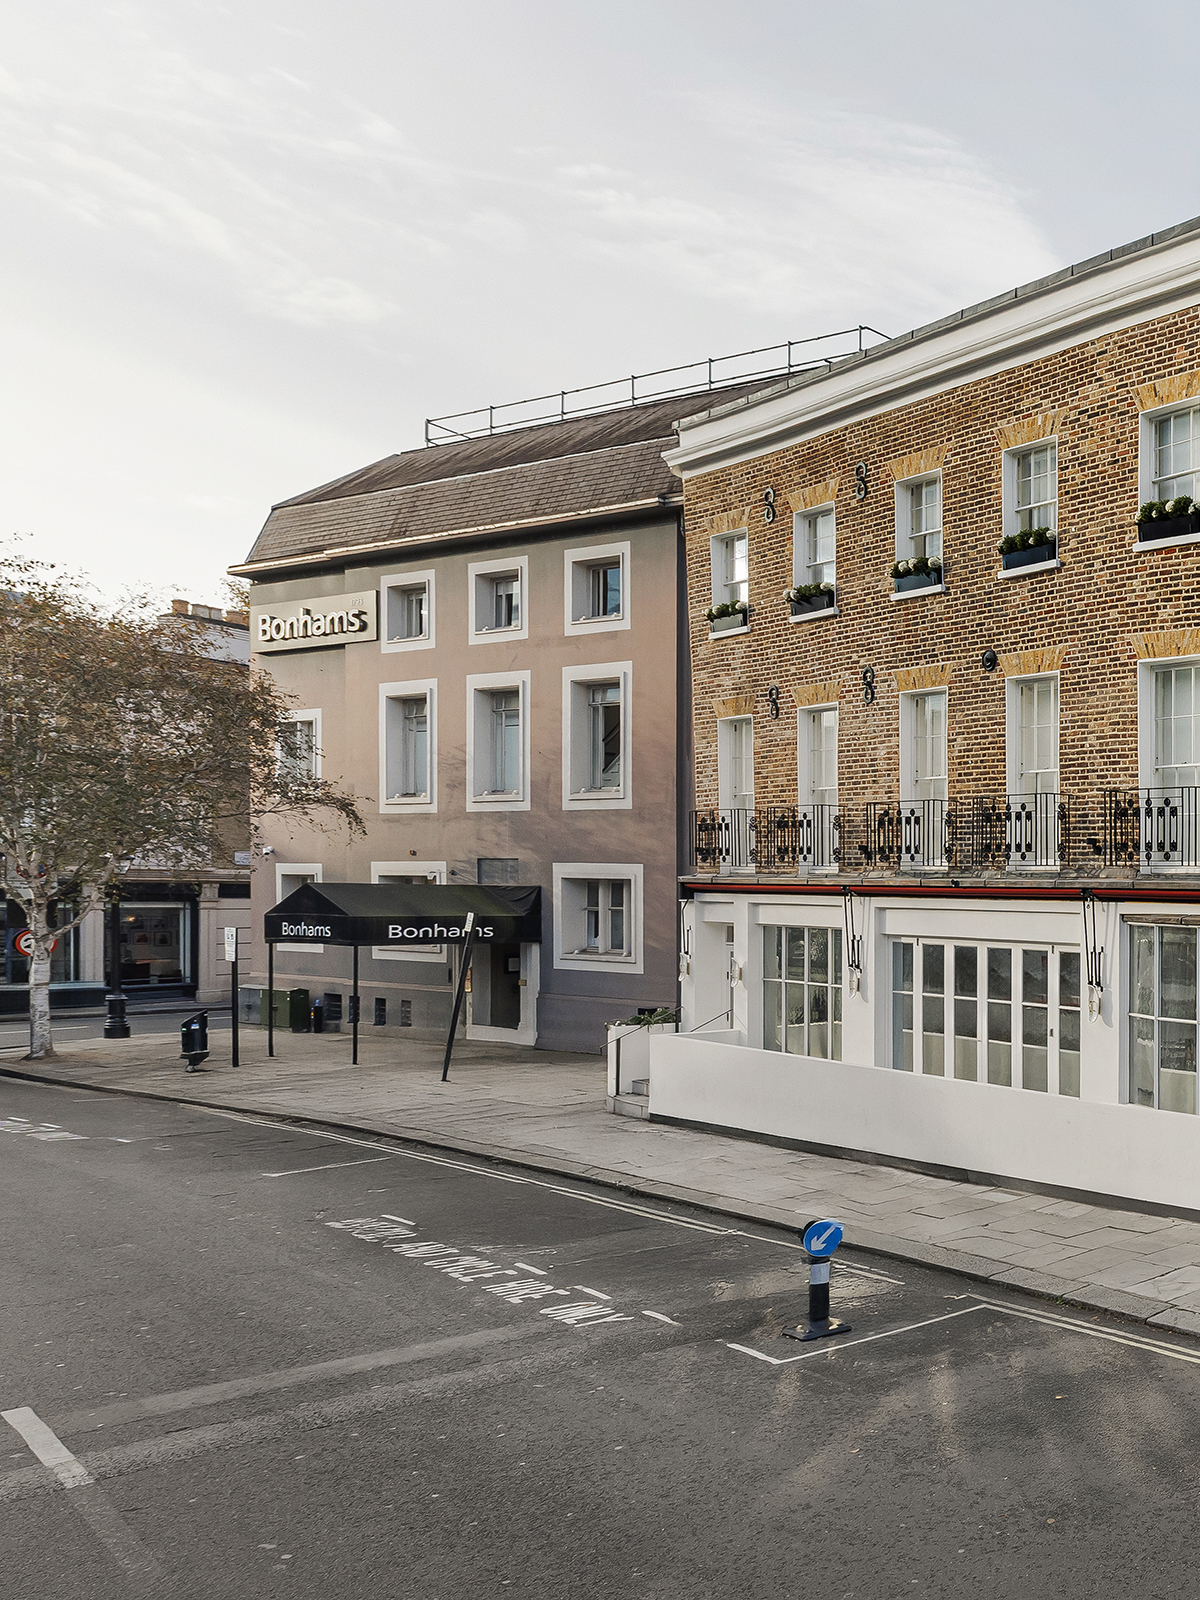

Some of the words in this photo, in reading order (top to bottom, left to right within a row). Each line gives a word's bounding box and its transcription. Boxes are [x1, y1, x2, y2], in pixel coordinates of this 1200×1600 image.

[258, 607, 361, 641] Bonhams
[281, 921, 332, 937] Bonhams
[539, 1301, 634, 1327] ONLY
